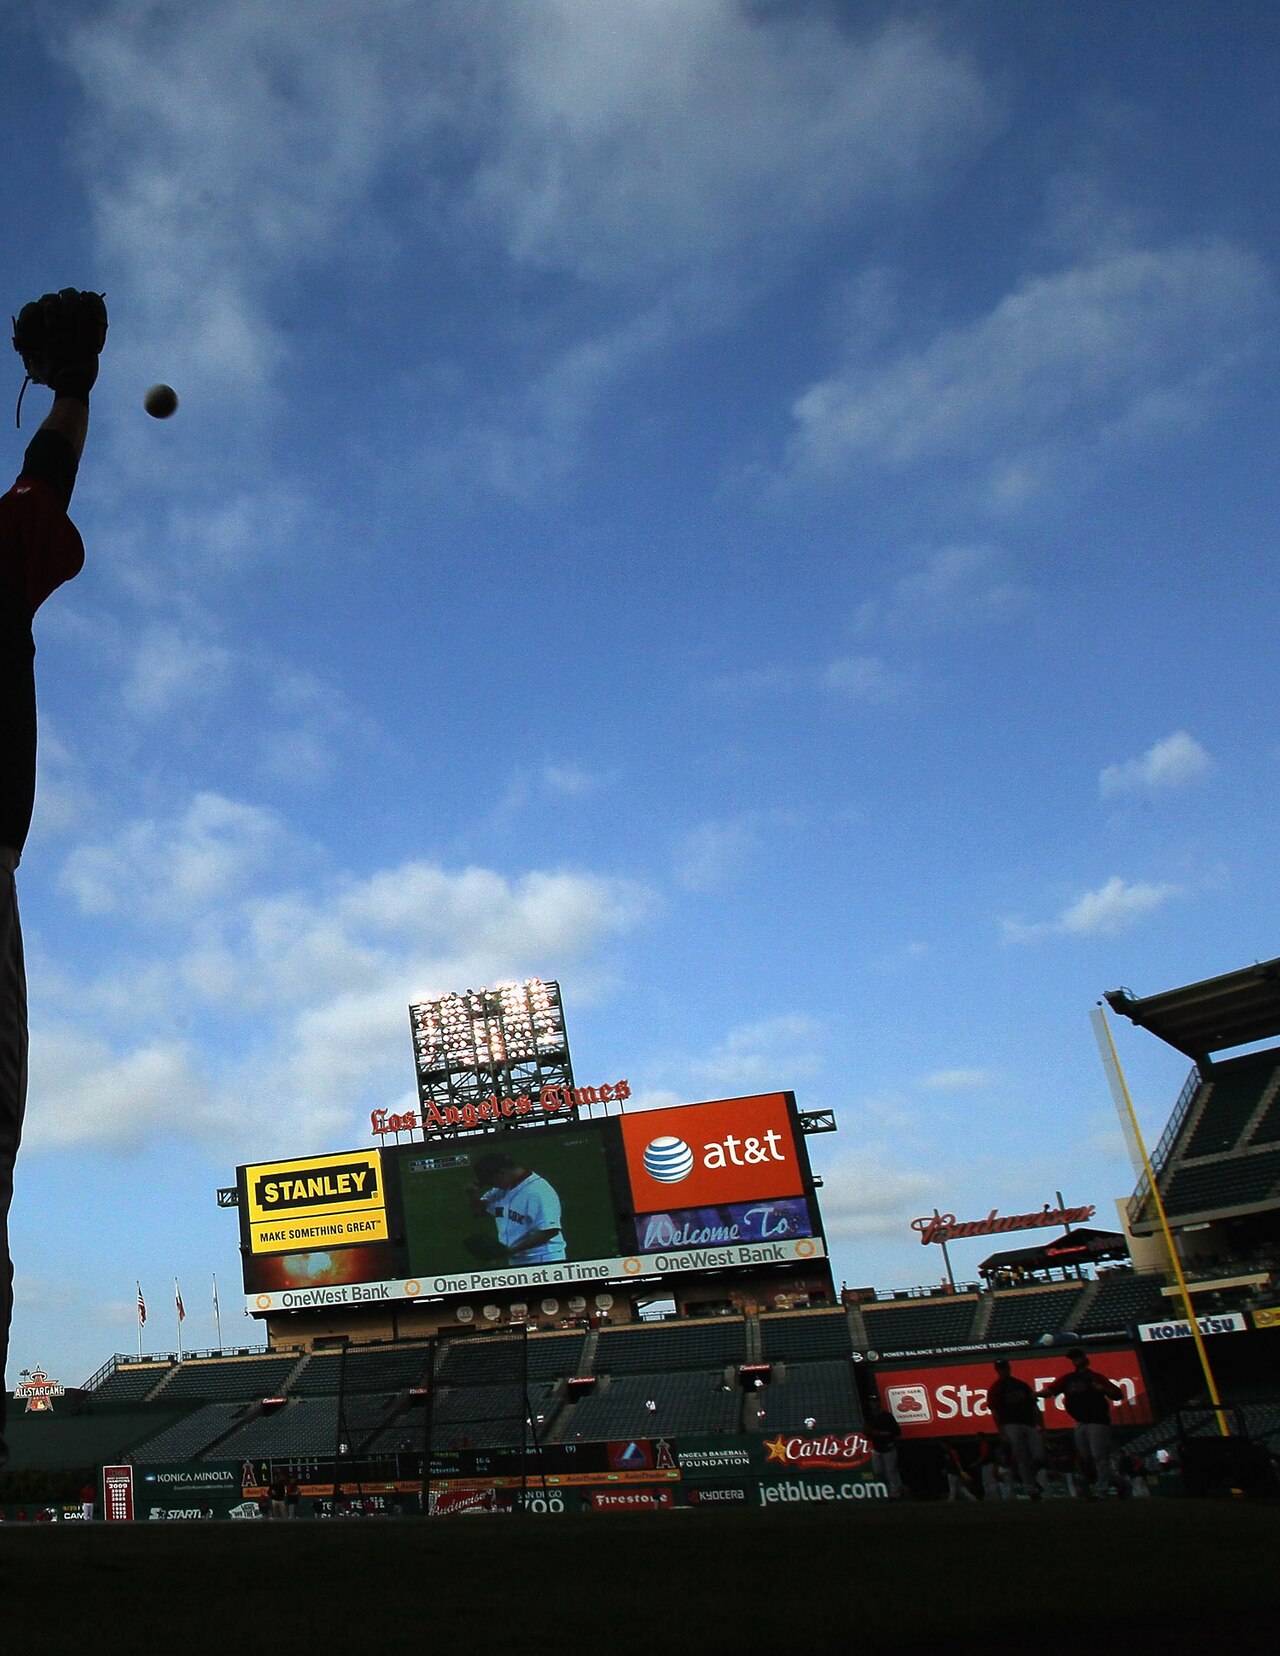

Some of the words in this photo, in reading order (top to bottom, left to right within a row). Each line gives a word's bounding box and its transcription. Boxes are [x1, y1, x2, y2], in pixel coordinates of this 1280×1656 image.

[371, 1108, 416, 1135] Los
[423, 1092, 531, 1129] Angeles
[540, 1079, 632, 1112] Times
[703, 1129, 785, 1169] at&t
[265, 1171, 366, 1203] STANLEY
[260, 1231, 286, 1242] MAKE
[289, 1224, 343, 1239] SOMETHING
[644, 1214, 740, 1248] Welcome
[744, 1207, 788, 1237] To
[911, 1204, 1096, 1245] Budweiser
[656, 1249, 734, 1271] OneWest
[739, 1244, 785, 1263] Bank
[434, 1277, 467, 1293] One
[471, 1273, 529, 1290] Person
[533, 1269, 550, 1283] at
[555, 1271, 564, 1281] a
[565, 1263, 610, 1280] Time
[282, 1288, 347, 1307] OneWest
[352, 1284, 389, 1300] Bank
[943, 1343, 987, 1353] PERFORMANCE
[45, 1385, 64, 1396] GAME
[935, 1385, 991, 1418] Sta
[786, 1436, 841, 1459] Carl's
[680, 1458, 750, 1467] FOUNDATION
[157, 1472, 193, 1483] KONICA
[193, 1470, 234, 1482] MINOLTA
[536, 1490, 562, 1498] DIGO
[699, 1490, 744, 1501] KYOCERA
[759, 1481, 888, 1507] jetblue.com
